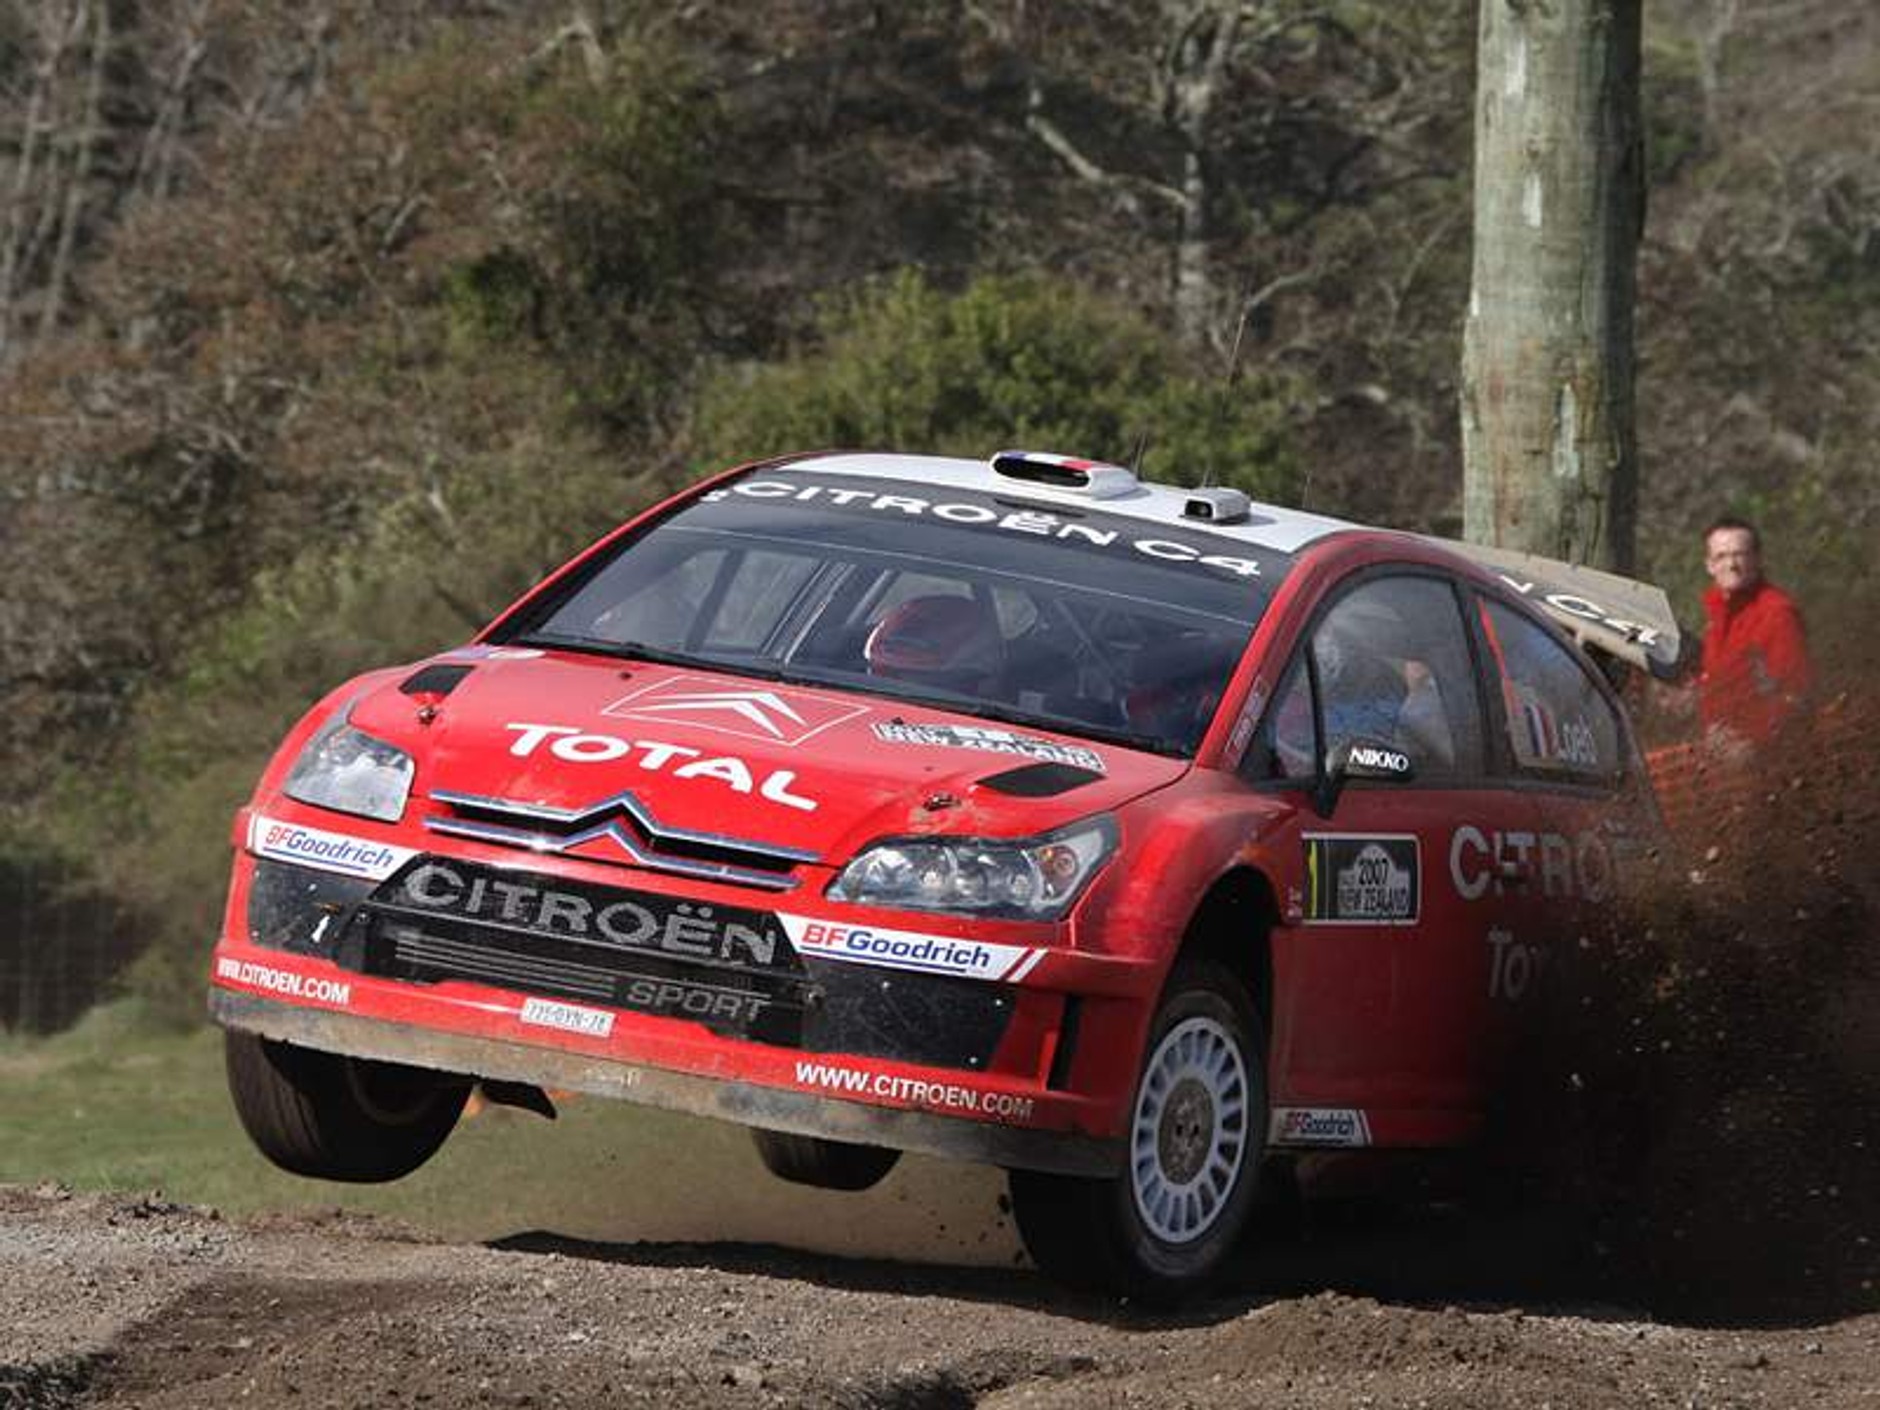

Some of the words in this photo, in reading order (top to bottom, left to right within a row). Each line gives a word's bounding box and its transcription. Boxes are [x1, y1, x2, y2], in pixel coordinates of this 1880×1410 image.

[733, 481, 1121, 547] CITROËN
[1132, 538, 1260, 577] C4
[505, 722, 820, 811] TOTAL
[1348, 747, 1409, 773] NIKKO
[264, 824, 394, 868] BFGoodrich
[404, 864, 777, 967] CITROËN
[801, 922, 991, 970] BFGoodrich
[627, 982, 771, 1022] SPORT
[795, 1061, 1034, 1122] WWW.CITROEN.COM
